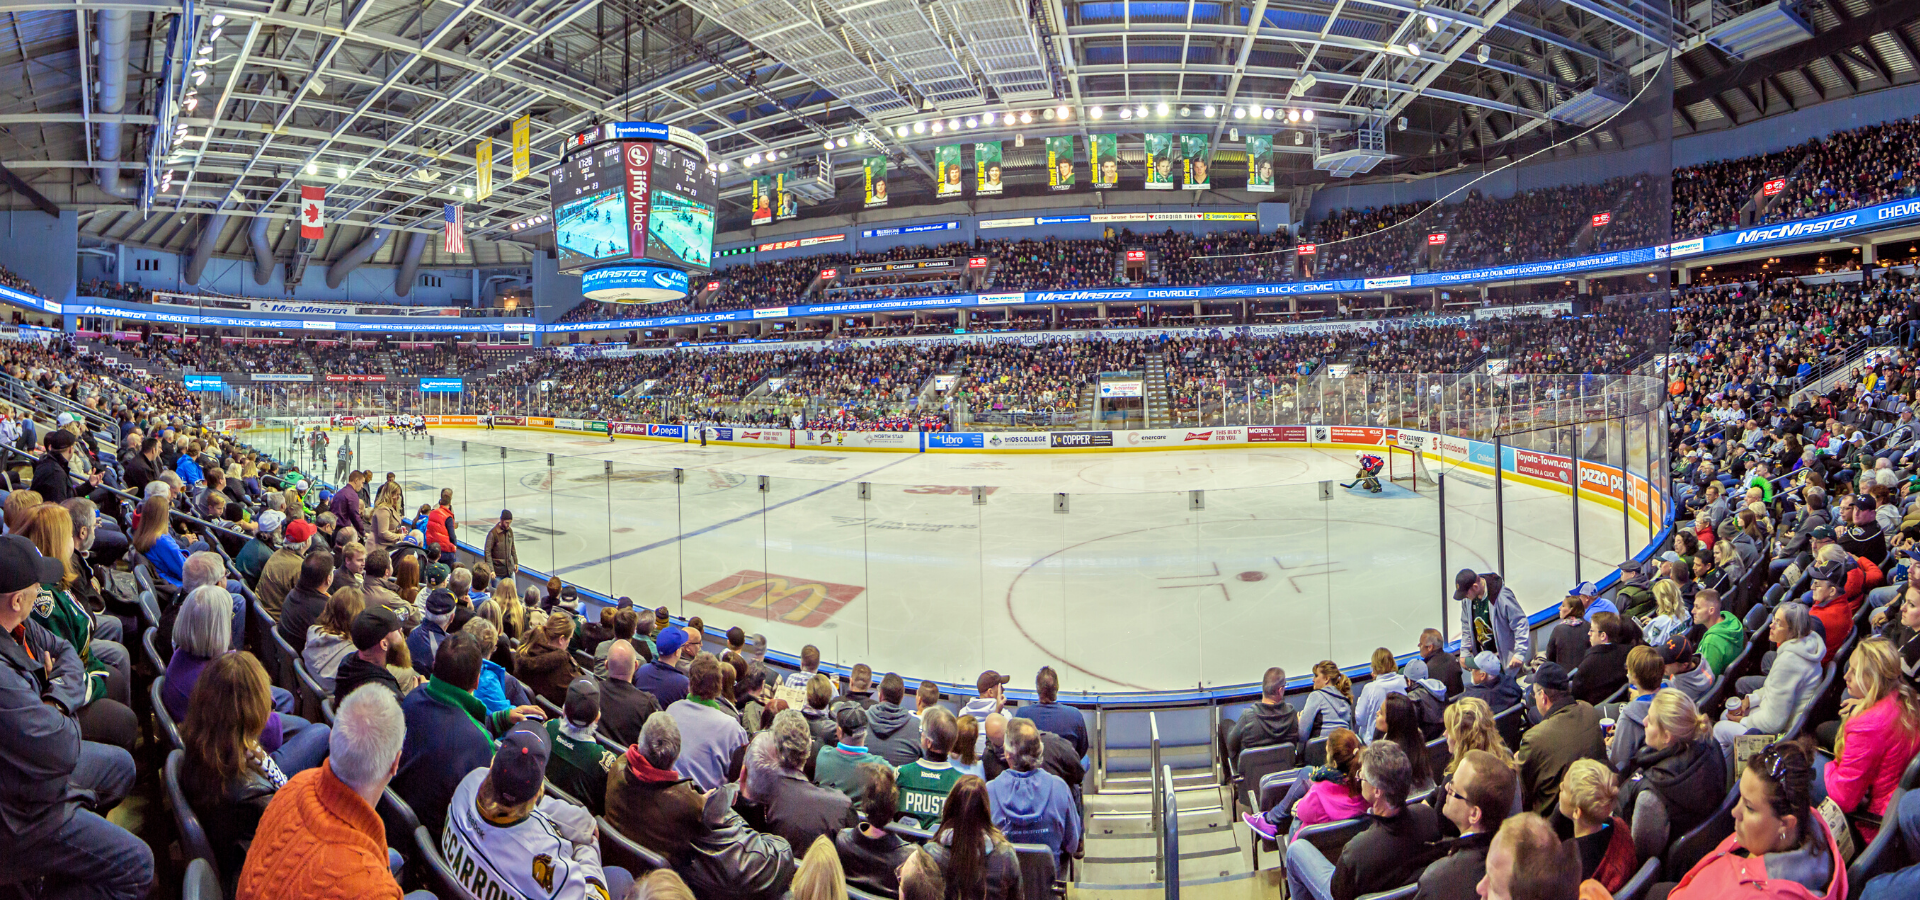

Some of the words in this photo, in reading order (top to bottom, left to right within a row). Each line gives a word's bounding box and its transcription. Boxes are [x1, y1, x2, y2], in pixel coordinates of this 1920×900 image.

[1520, 264, 1553, 274] LOCATION
[1577, 258, 1600, 266] DRIVER
[1303, 283, 1333, 292] GMC
[881, 338, 912, 348] Endless
[986, 333, 1039, 346] Unexpected
[1041, 333, 1072, 344] Places
[661, 426, 679, 435] pepsi
[942, 435, 963, 444] Libro
[1052, 435, 1057, 444] X
[1062, 435, 1090, 444] COPPER
[1407, 435, 1424, 443] GAMES
[1519, 466, 1535, 474] QUOTES
[1580, 467, 1608, 487] pizza
[1637, 488, 1648, 505] THE
[556, 735, 574, 750] Reebok
[921, 771, 941, 780] Reebok
[906, 792, 949, 814] PRUST
